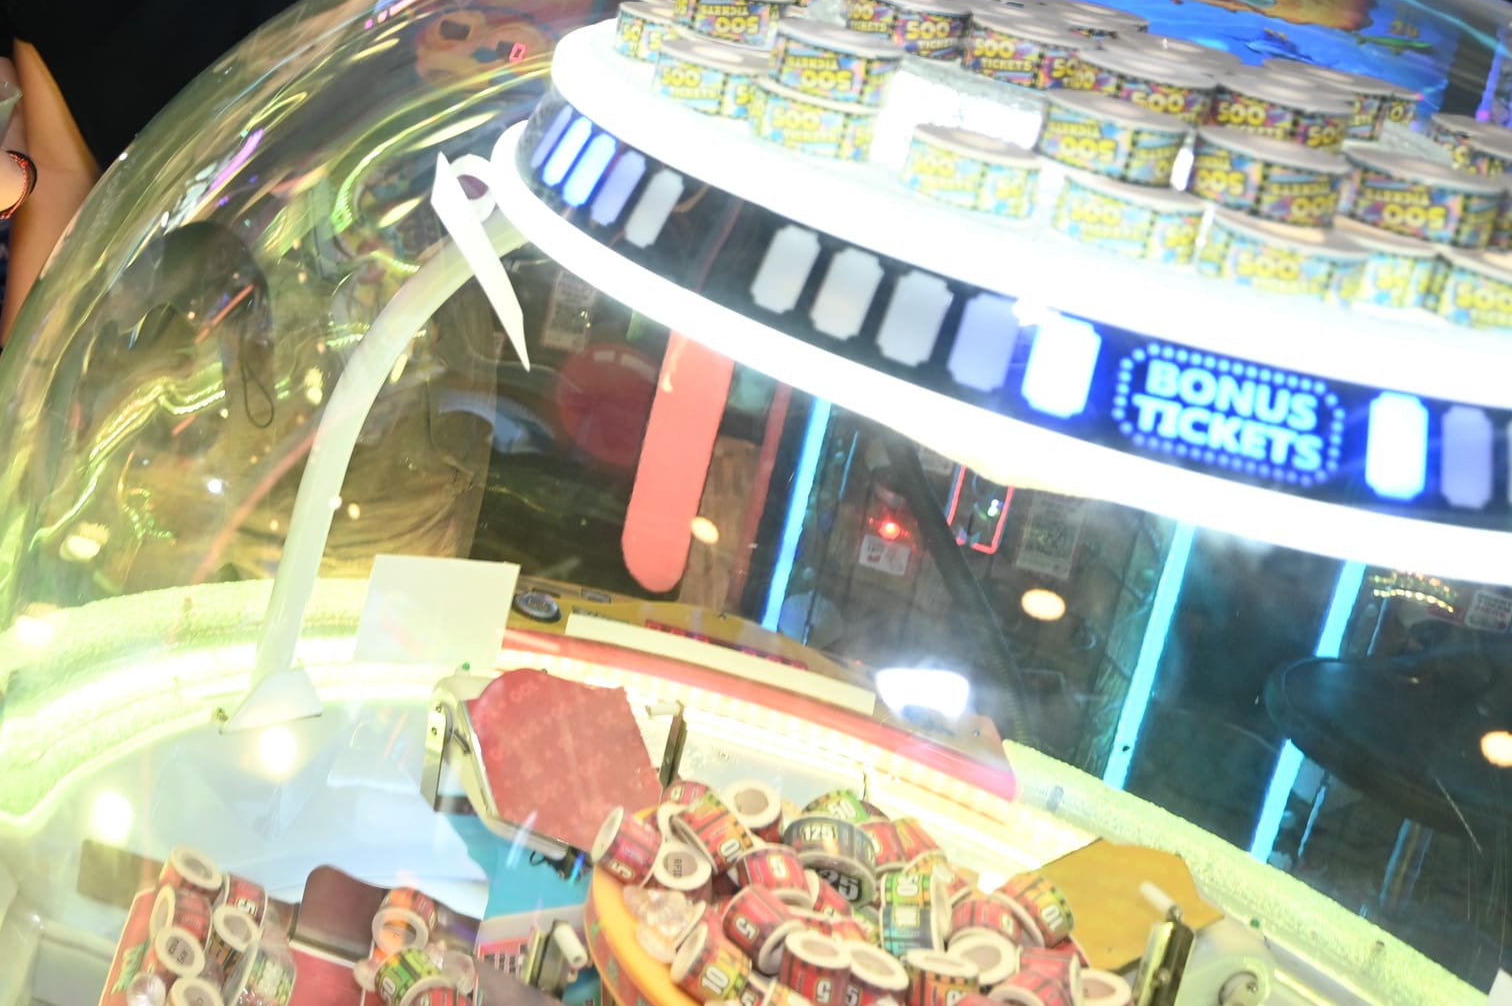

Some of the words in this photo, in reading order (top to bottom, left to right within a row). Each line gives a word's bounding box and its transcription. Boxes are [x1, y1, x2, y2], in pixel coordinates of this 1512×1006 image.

[904, 19, 951, 41] 500
[973, 38, 1016, 58] 500
[1217, 104, 1266, 126] 500
[1144, 358, 1318, 432] BONUS
[1131, 392, 1324, 472] TICKETS
[736, 916, 758, 940] 5
[700, 964, 730, 995] 10
